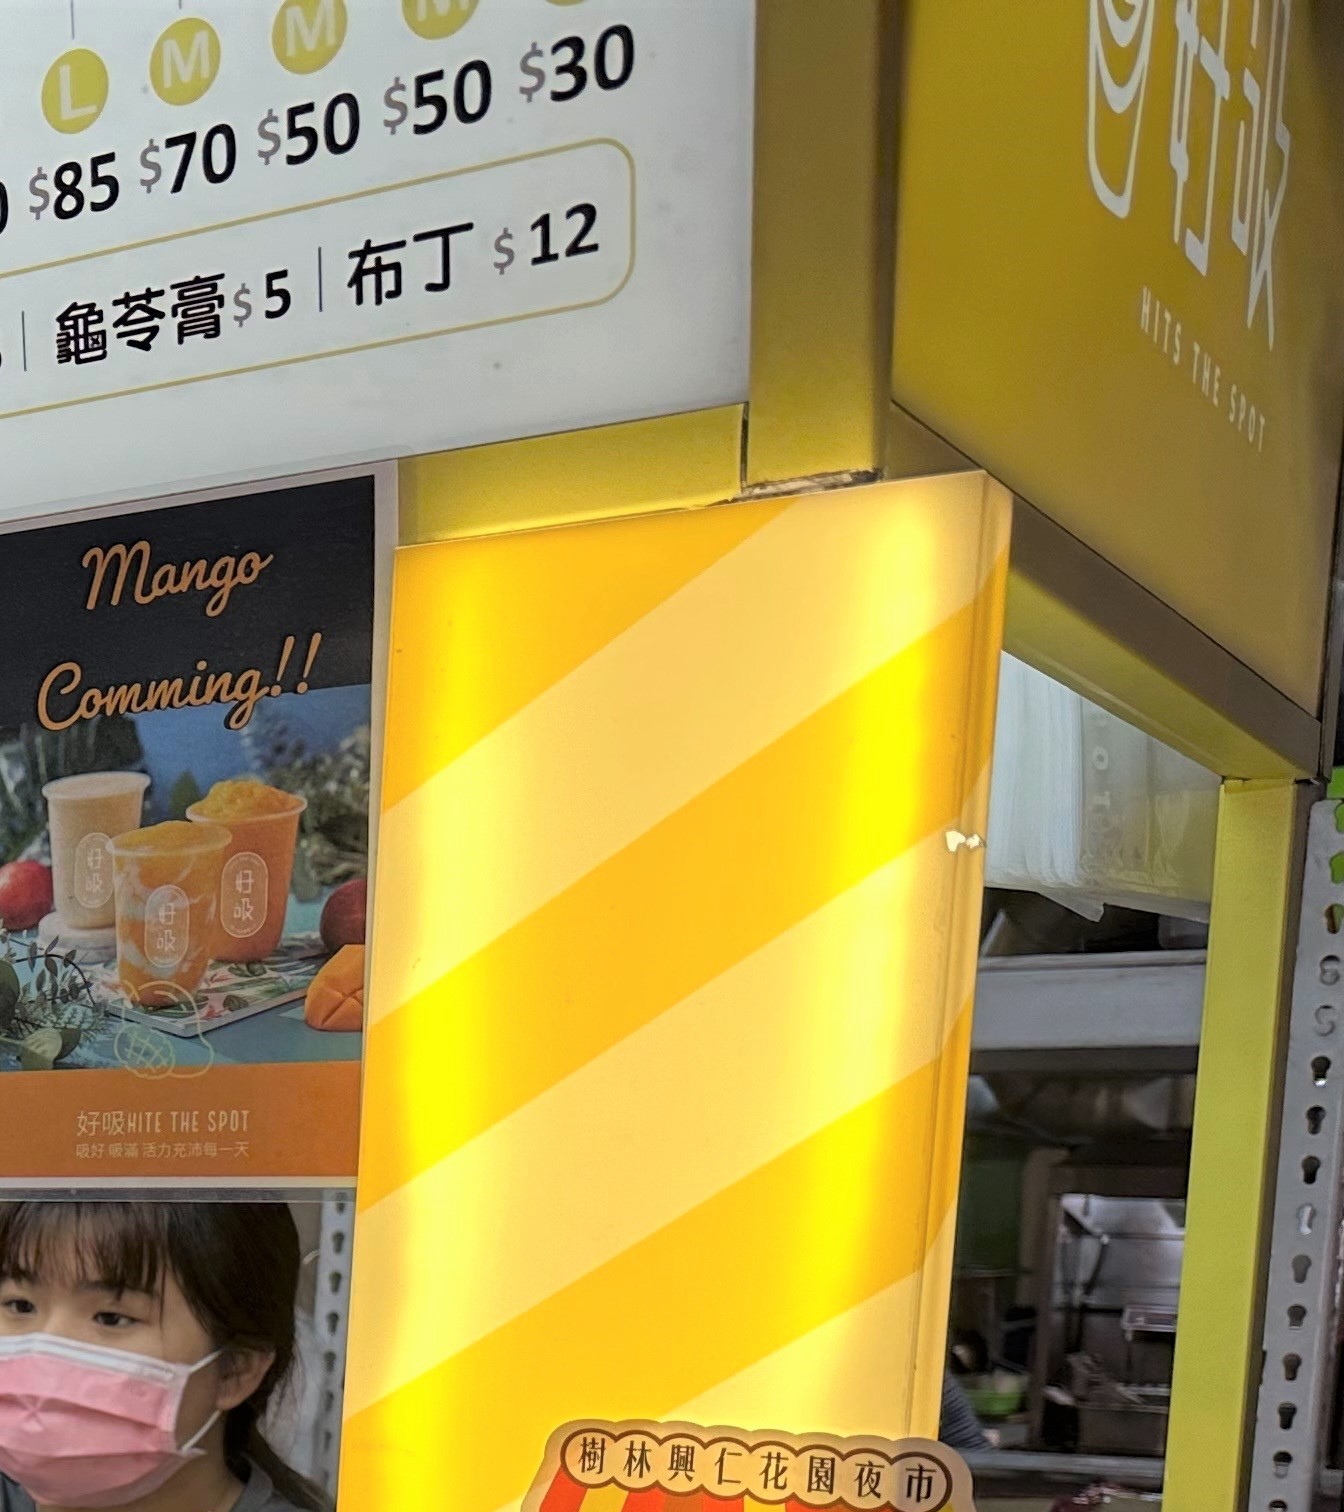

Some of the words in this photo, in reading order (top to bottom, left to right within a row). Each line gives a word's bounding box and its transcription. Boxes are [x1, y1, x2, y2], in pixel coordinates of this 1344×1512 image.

[58, 64, 98, 121] L
[162, 31, 210, 88] M
[28, 152, 120, 221] $85
[139, 123, 237, 194] $70
[257, 92, 360, 166] $50
[382, 59, 493, 136] $50
[518, 23, 635, 104] $30
[55, 273, 226, 365] 龜苓膏
[347, 222, 474, 307] 布丁
[1140, 286, 1182, 366] HITS
[1192, 341, 1222, 408] THE
[1228, 384, 1266, 453] SPOT
[81, 540, 274, 617] Mango
[37, 633, 323, 732] Comming!!
[170, 1109, 199, 1134] THE
[207, 1108, 251, 1134] SPOT
[578, 1436, 939, 1504] 樹林興仁花園夜市
